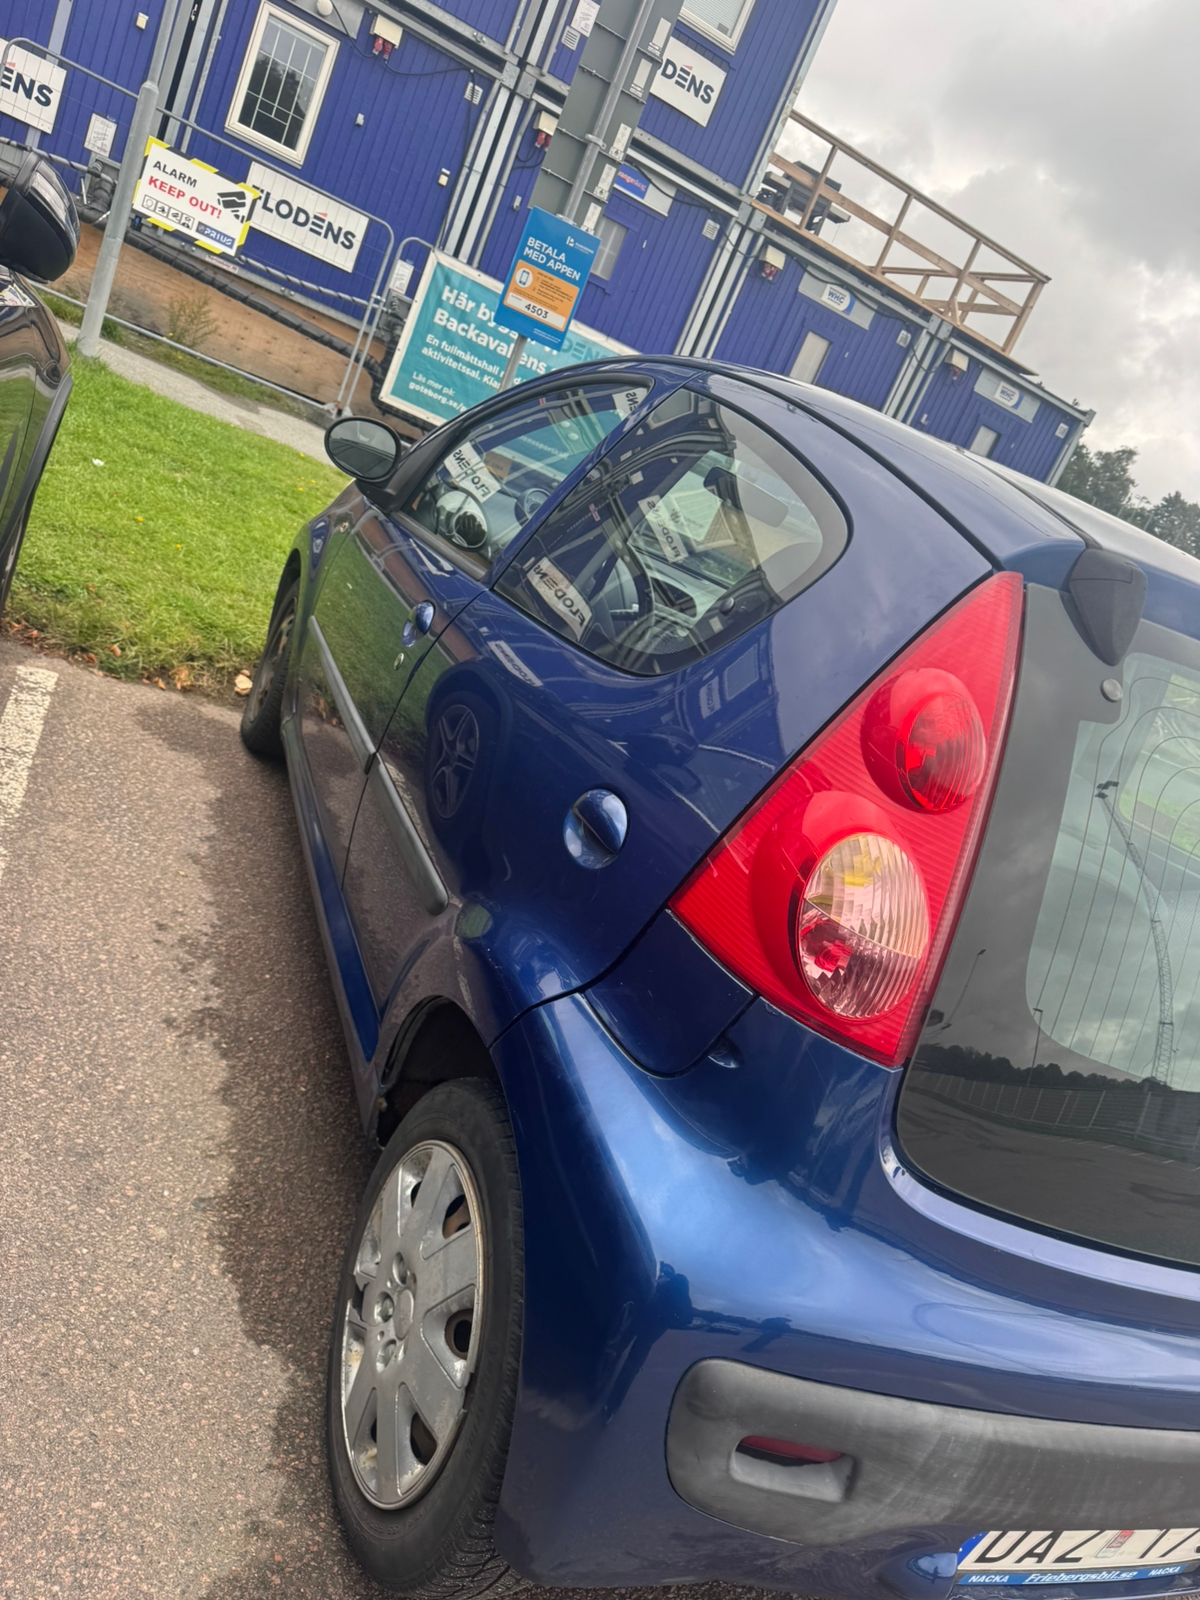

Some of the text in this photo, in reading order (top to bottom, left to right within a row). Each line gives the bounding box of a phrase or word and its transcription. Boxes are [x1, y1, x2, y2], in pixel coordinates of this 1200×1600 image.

[152, 160, 198, 188] ALARM
[147, 175, 223, 220] KEEP OUT!
[203, 226, 233, 246] PRIUS
[526, 236, 567, 263] BETALA
[523, 246, 581, 282] MED APPEN
[441, 285, 476, 313] Här
[827, 288, 846, 305] WHC
[524, 303, 550, 320] 4503
[425, 333, 440, 347] En
[433, 307, 548, 375] Backavalens
[421, 346, 481, 380] aktivitetssal.
[967, 1565, 1182, 1584] NACKA Friebergsbil.se NACKA
